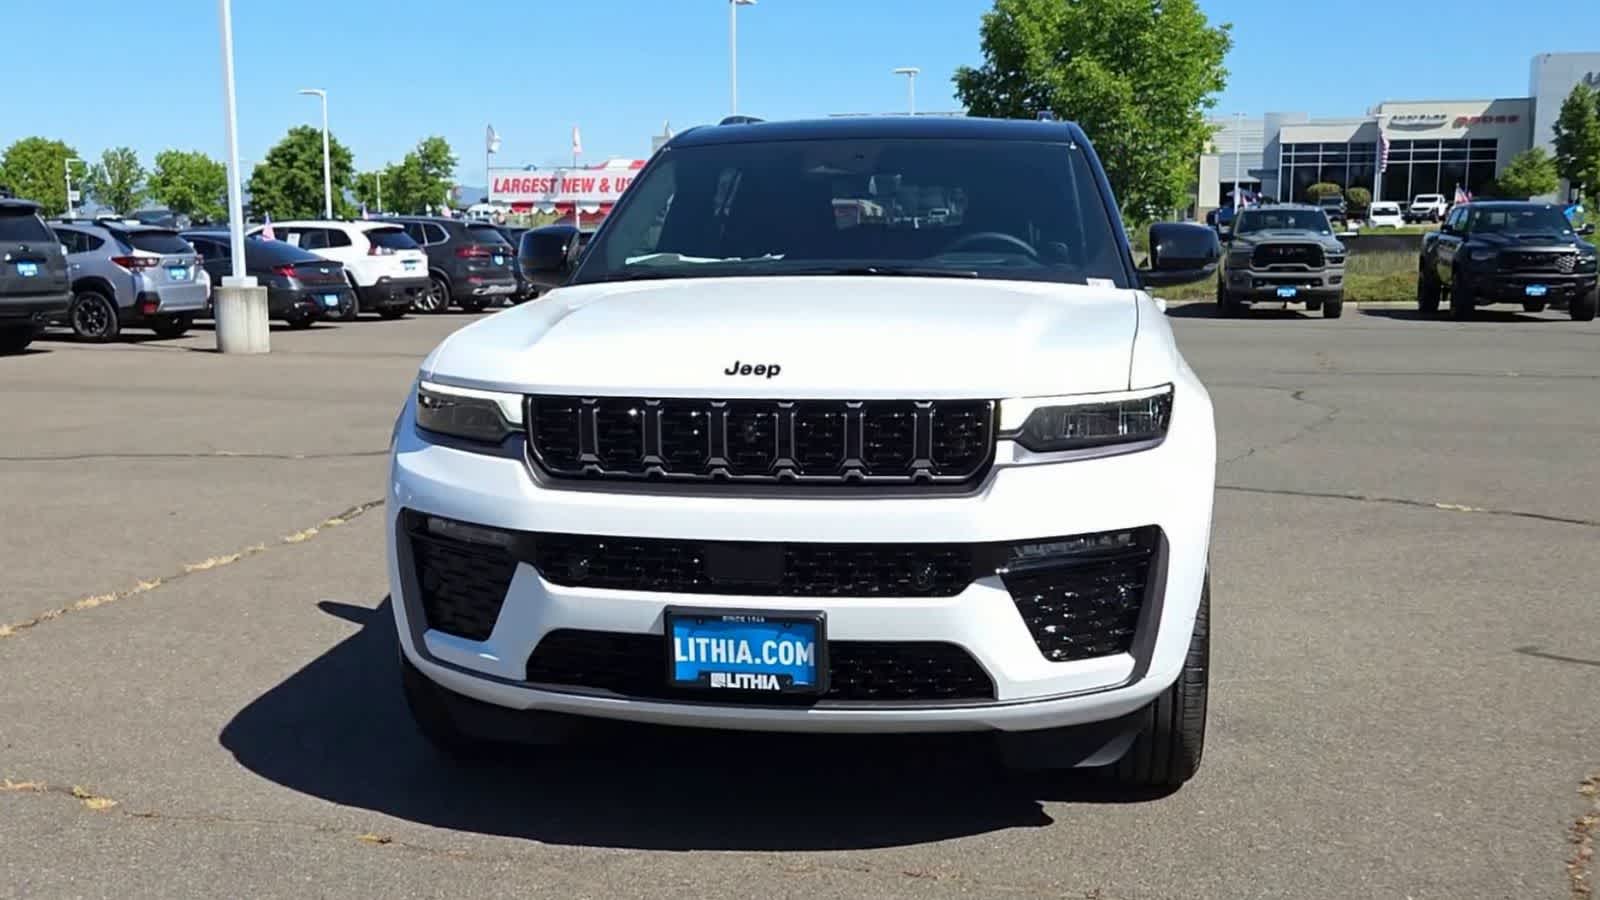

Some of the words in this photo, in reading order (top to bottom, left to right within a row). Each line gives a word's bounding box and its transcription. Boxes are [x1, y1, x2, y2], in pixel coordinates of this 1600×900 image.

[493, 178, 558, 193] LARGEST
[561, 178, 595, 193] NEW
[600, 178, 610, 193] &
[724, 360, 781, 379] Jeep
[674, 637, 815, 667] LITHIA.COM
[727, 673, 781, 690] LITHIA
